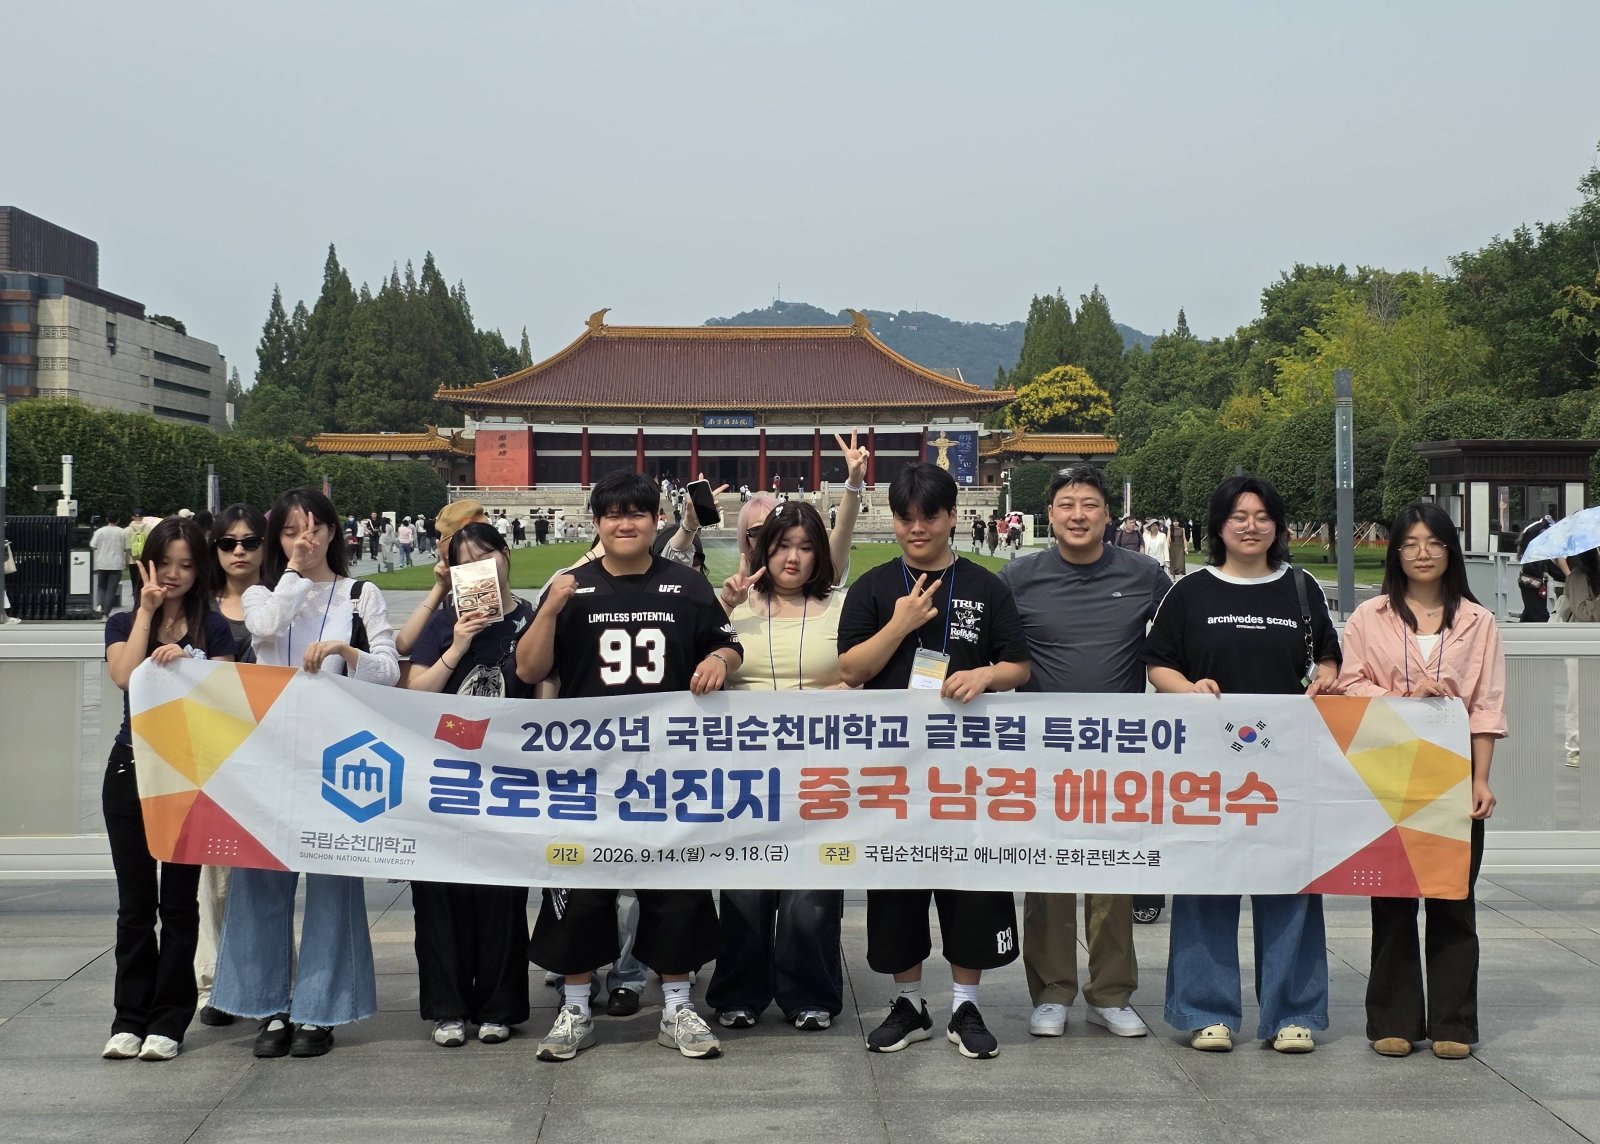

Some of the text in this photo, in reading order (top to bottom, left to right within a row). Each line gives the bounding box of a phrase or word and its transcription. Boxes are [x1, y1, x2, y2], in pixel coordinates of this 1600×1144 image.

[658, 584, 682, 594] UFC
[952, 599, 985, 612] TRUE
[589, 611, 676, 623] LIMITLESS POTENTIAL
[1207, 614, 1264, 625] arcnivedes
[1266, 616, 1298, 629] sczots
[599, 628, 666, 686] 93
[520, 713, 1187, 755] 2026년 국립순천대학교 글로컬 특화분야
[428, 758, 1279, 826] 글로벌 선진지 중국 남경 해외연수
[300, 831, 417, 854] 국립순천대학교
[300, 851, 416, 866] SUNCHON NATIONAL UNIVERSITY
[552, 847, 579, 862] 기간
[825, 847, 851, 862] 주관
[864, 845, 969, 863] 국립순천대학교
